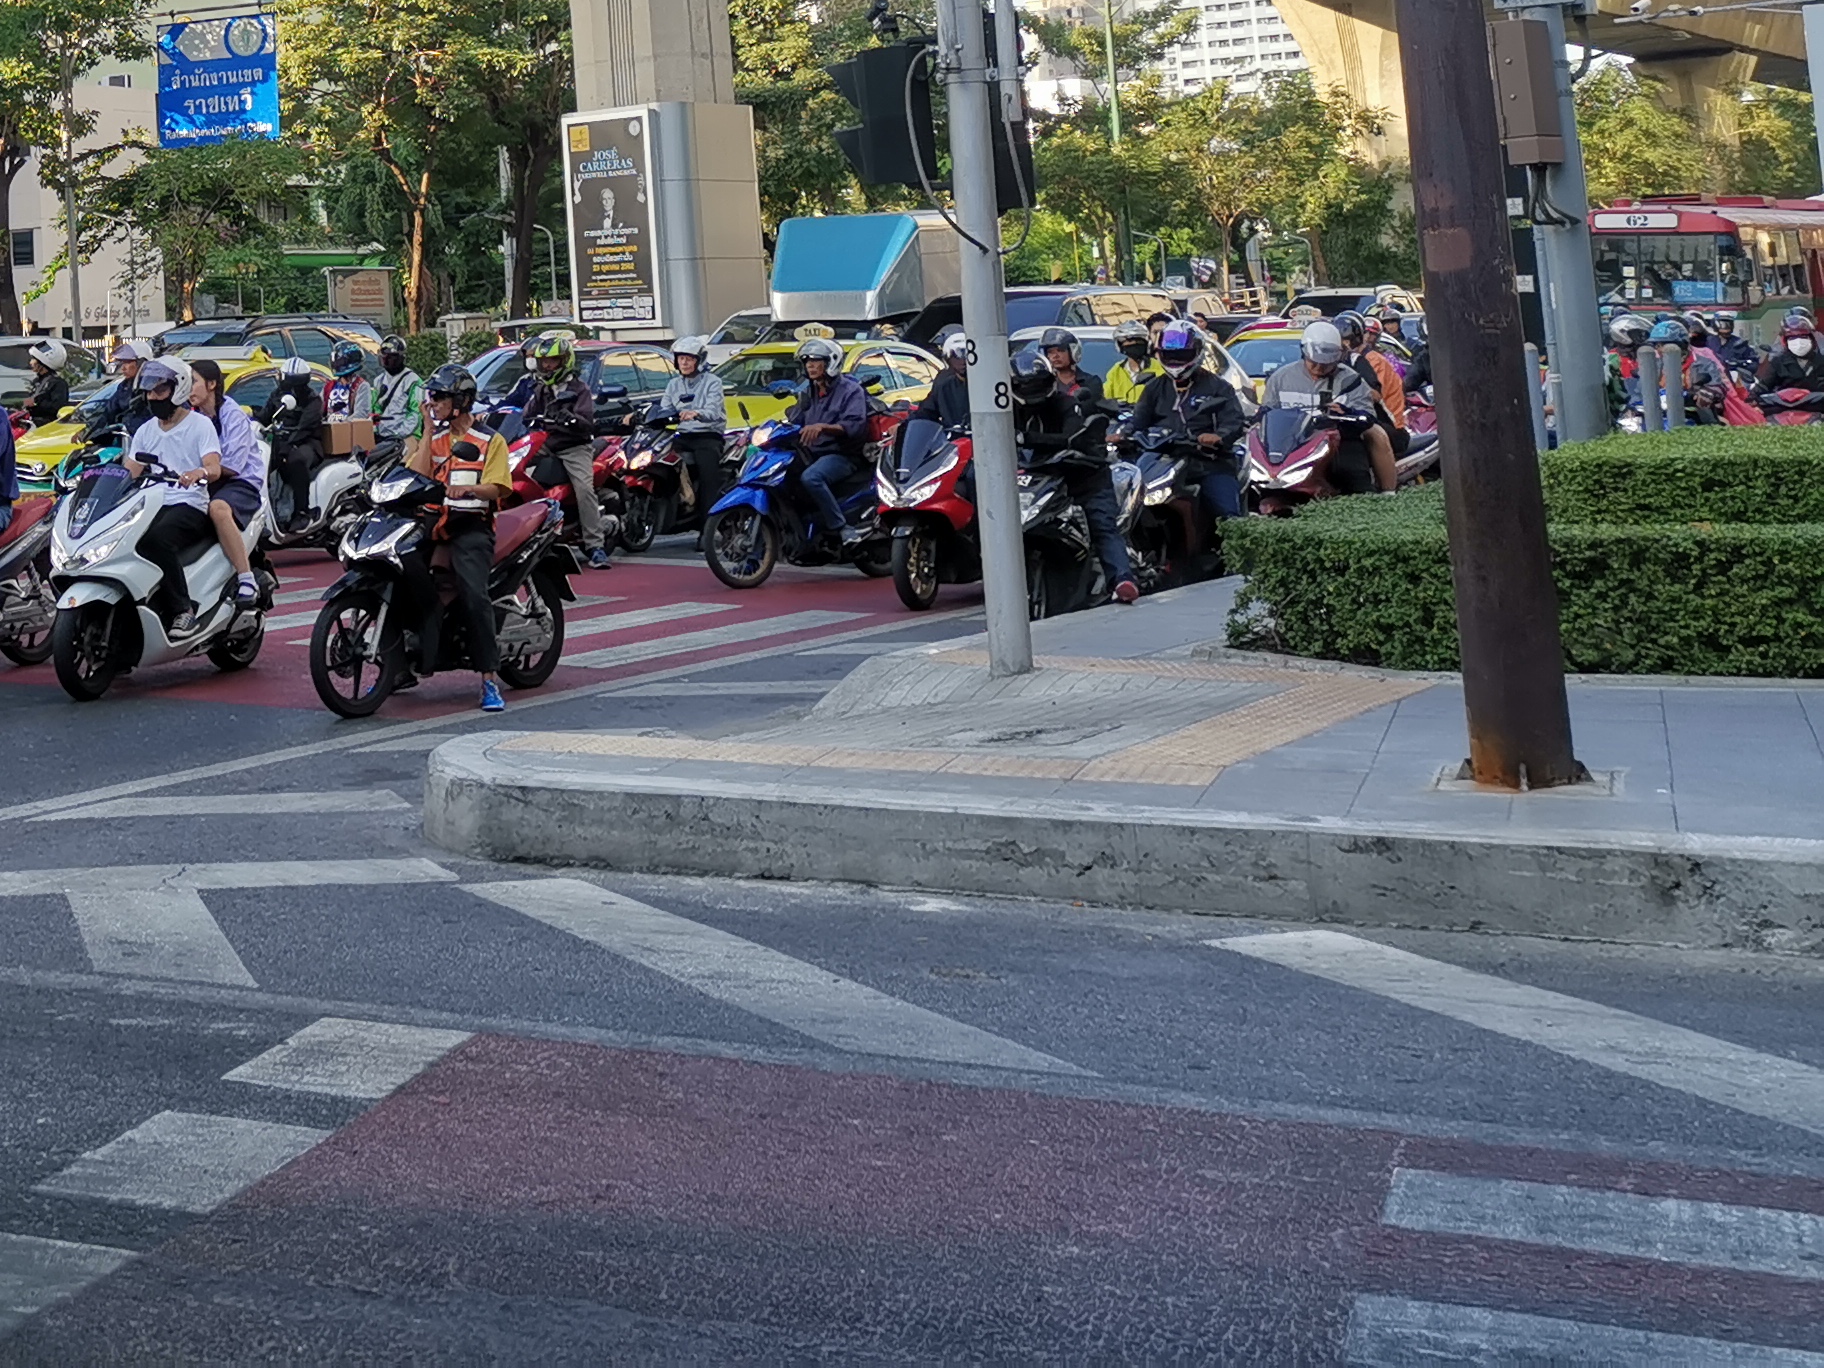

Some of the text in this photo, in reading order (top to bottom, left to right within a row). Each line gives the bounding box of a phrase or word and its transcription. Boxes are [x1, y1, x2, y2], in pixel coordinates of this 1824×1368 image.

[171, 66, 263, 90] สำนักงานเขต
[184, 86, 253, 115] ราชเทวี
[592, 146, 619, 161] JOSÉ
[579, 158, 633, 173] CARRERAS
[1626, 215, 1649, 227] 62
[803, 327, 821, 337] TAXI
[966, 339, 978, 366] 8
[994, 381, 1009, 409] 8
